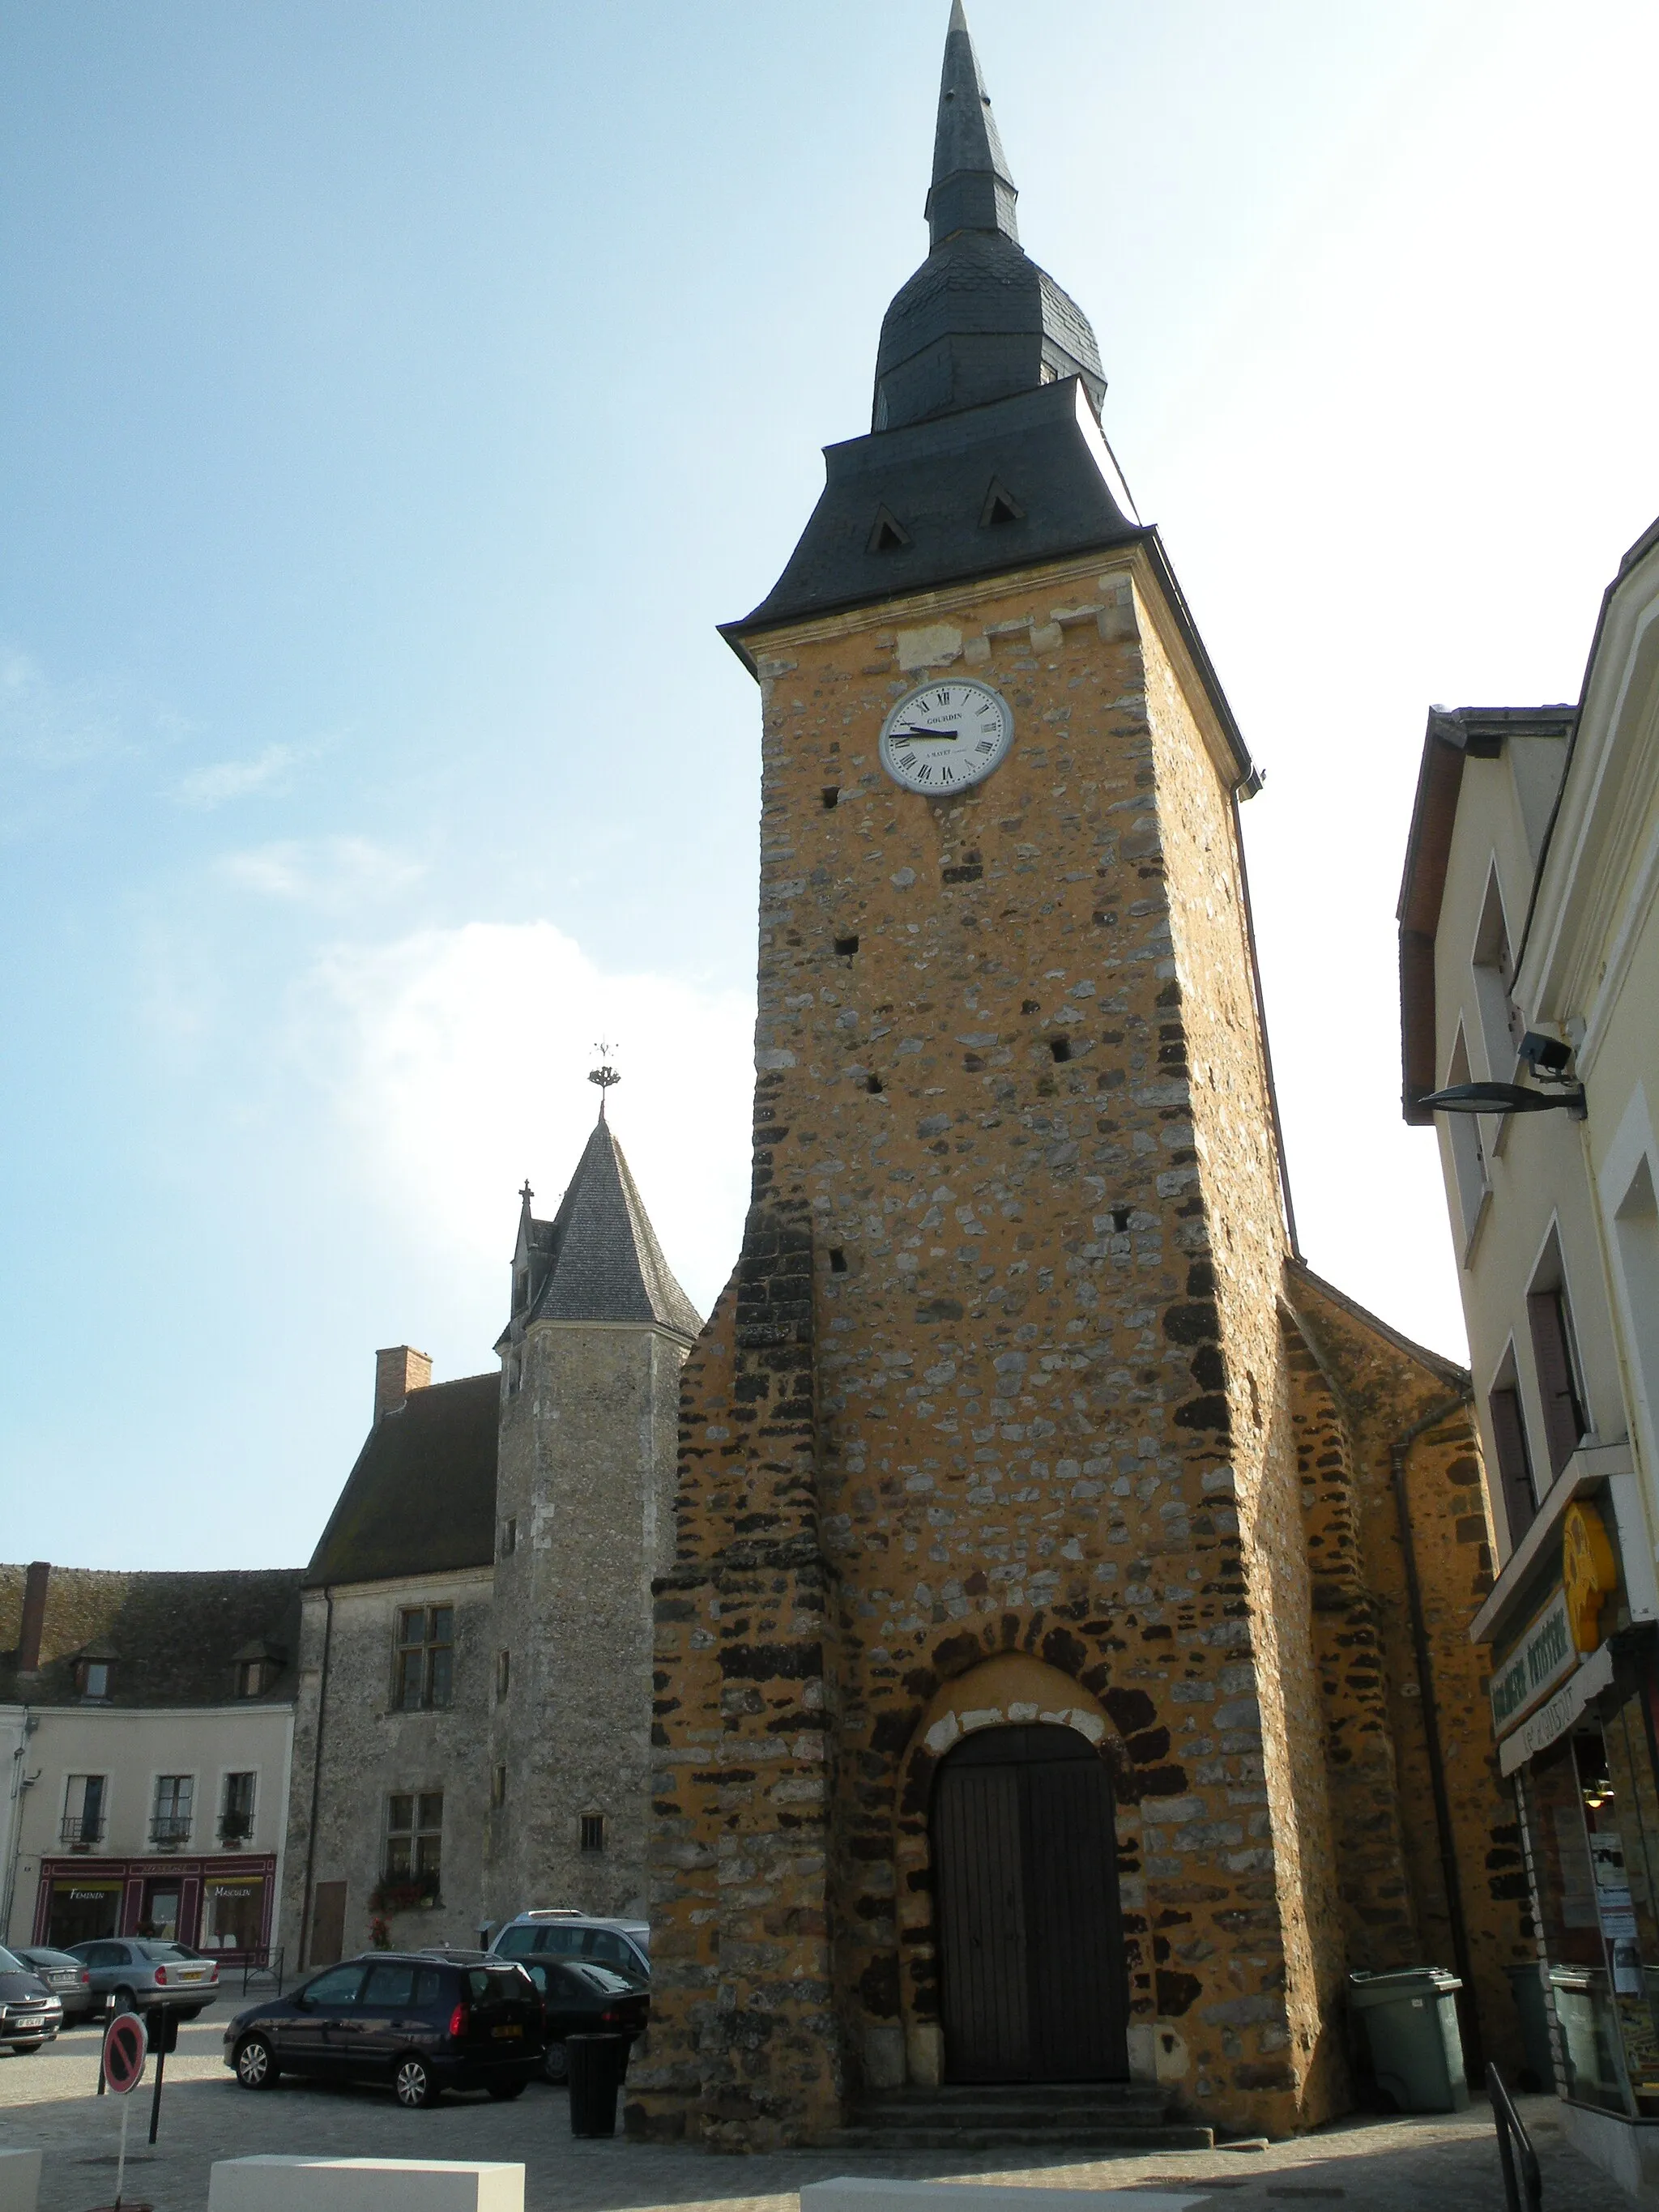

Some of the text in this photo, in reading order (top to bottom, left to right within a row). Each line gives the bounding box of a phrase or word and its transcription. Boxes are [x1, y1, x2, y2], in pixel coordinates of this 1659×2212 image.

[937, 692, 950, 706] XII
[915, 700, 930, 716] XI
[975, 703, 989, 717] II
[927, 713, 962, 725] GOURDIN
[981, 721, 996, 733] III
[917, 764, 932, 780] VII
[942, 765, 953, 780] VI
